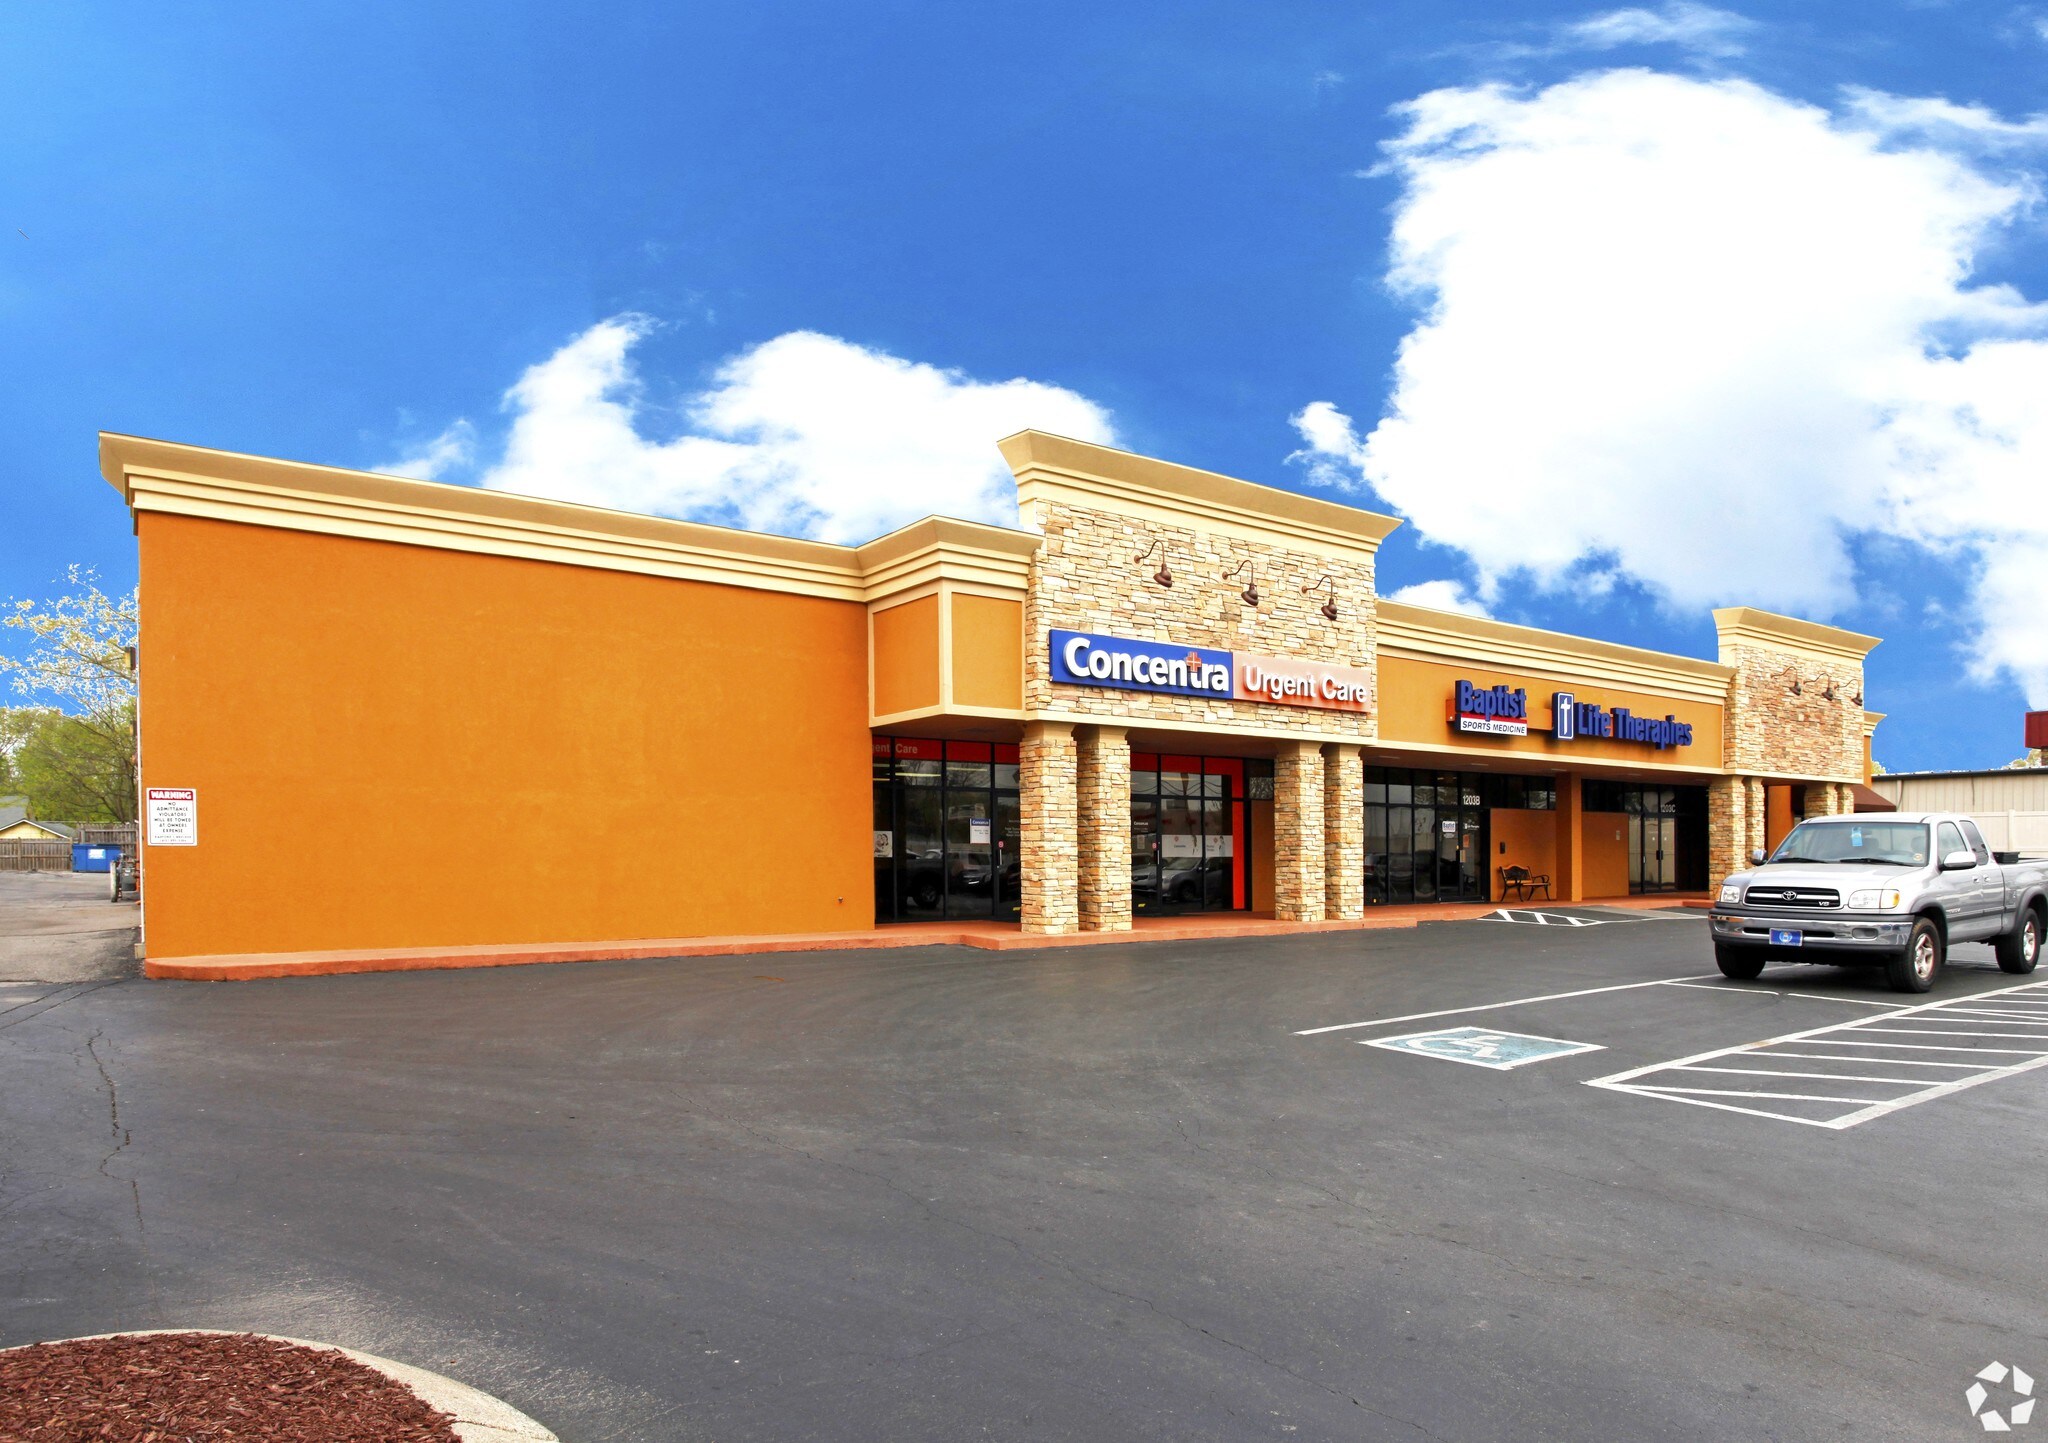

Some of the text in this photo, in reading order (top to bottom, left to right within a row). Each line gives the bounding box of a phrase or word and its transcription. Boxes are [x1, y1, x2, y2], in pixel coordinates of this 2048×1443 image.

[1063, 636, 1368, 703] Concentra Urgent Care
[1456, 680, 1527, 722] Baptist
[1462, 720, 1526, 734] SPORTS MEDICINE
[1574, 702, 1693, 750] Life Therapies
[895, 743, 918, 754] Care
[150, 790, 192, 800] WARNING
